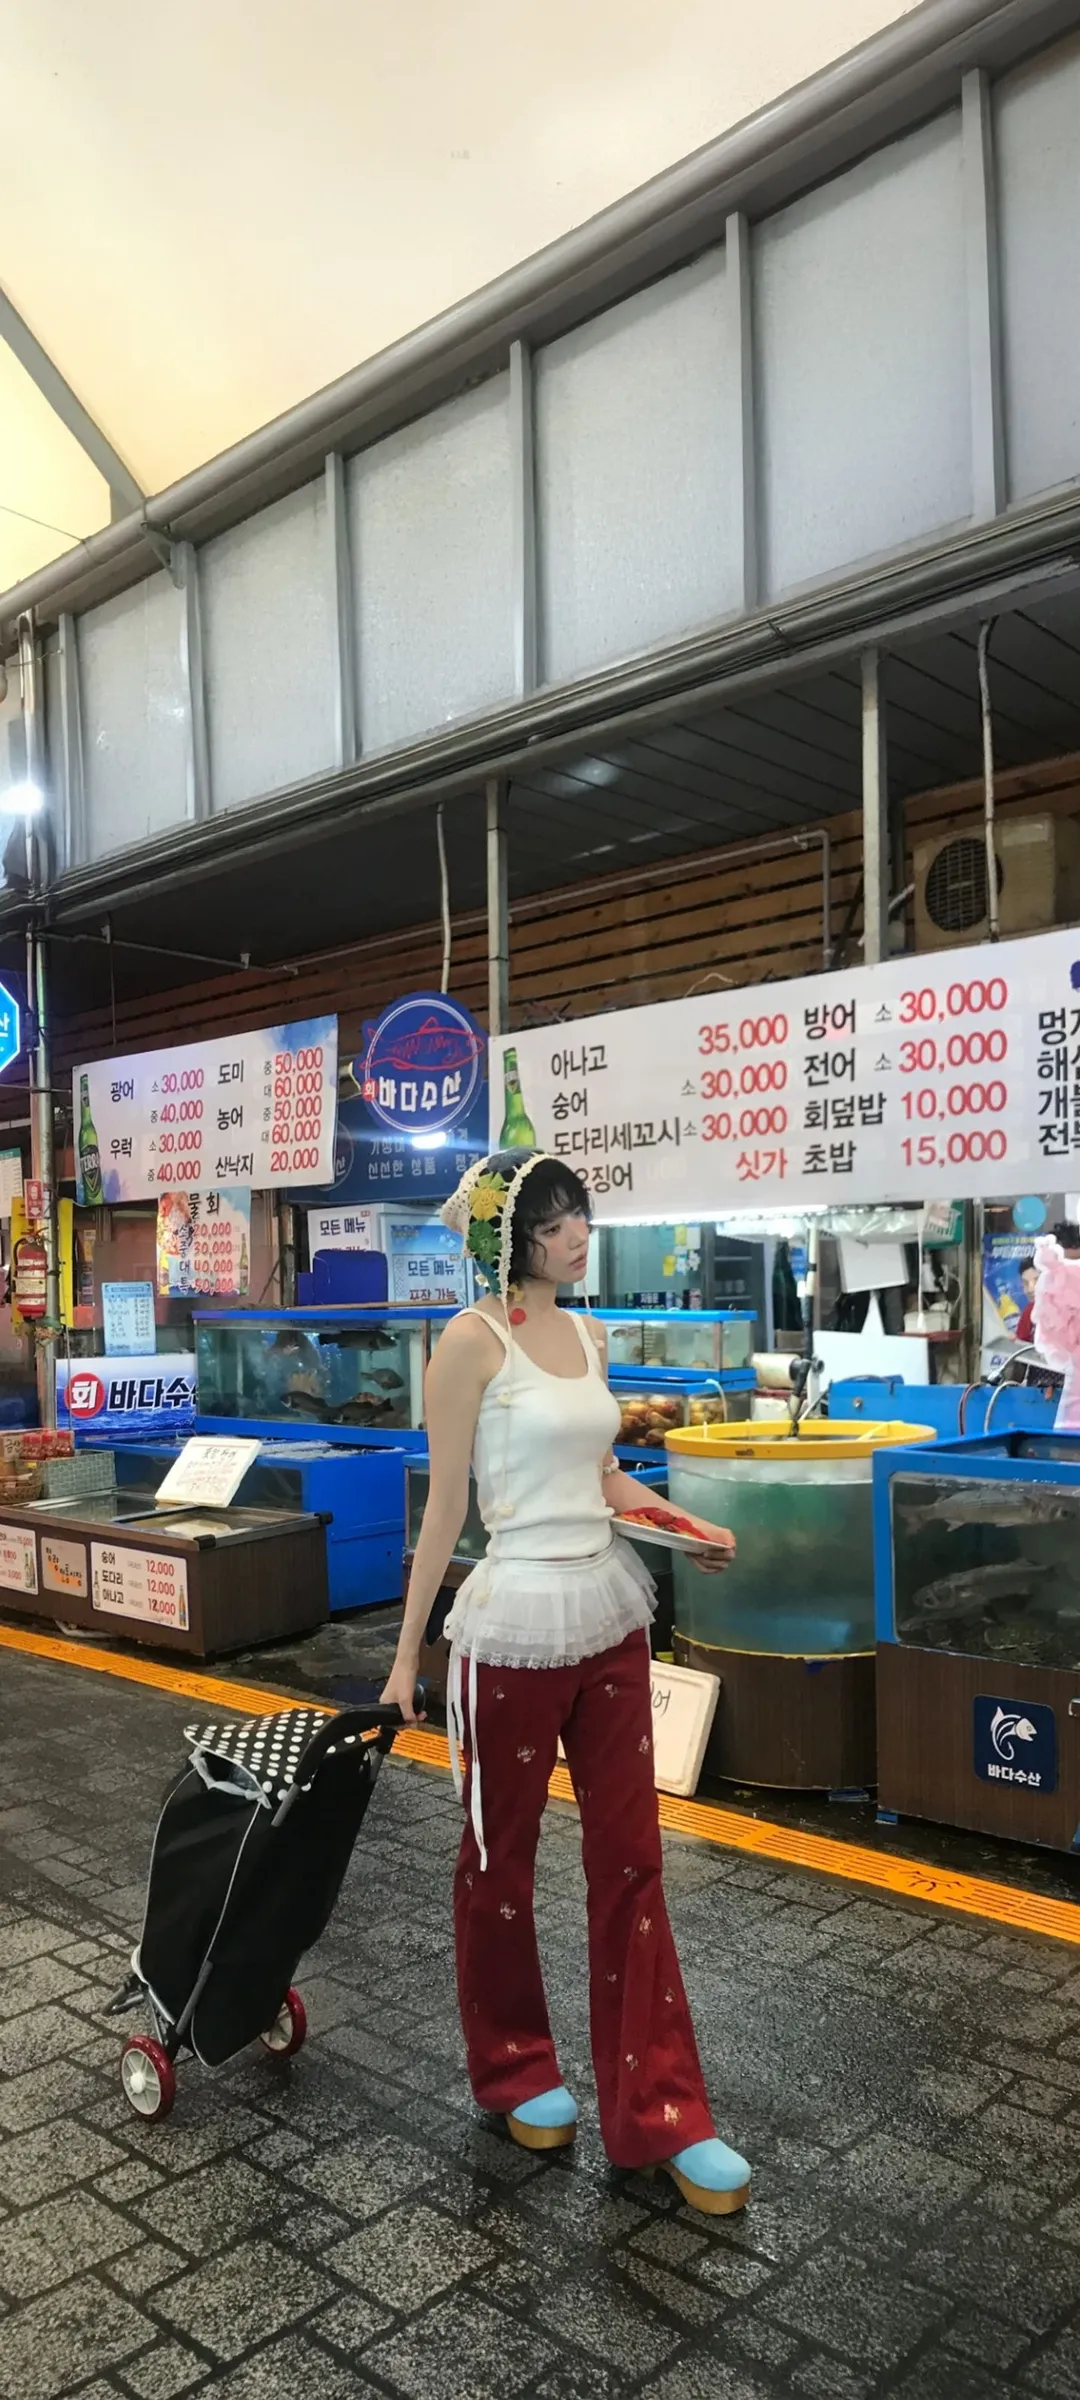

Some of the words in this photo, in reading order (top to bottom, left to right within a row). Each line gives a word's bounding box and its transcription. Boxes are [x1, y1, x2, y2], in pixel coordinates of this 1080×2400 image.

[804, 999, 856, 1040] 방어
[875, 1004, 892, 1022] 소
[899, 978, 1008, 1024] 30,000
[551, 1045, 608, 1079] 아나고
[698, 1014, 788, 1055] 35,000
[804, 1047, 855, 1087] 전어
[874, 1053, 892, 1071] 소
[899, 1030, 1008, 1073] 30,000
[218, 1060, 244, 1084] 도미
[275, 1047, 323, 1075] 50,000
[110, 1078, 134, 1102] 광어
[161, 1068, 204, 1095] 30,000
[274, 1071, 323, 1098] 60,000
[379, 1071, 461, 1112] 바다수산
[552, 1088, 588, 1120] 숭어
[681, 1079, 696, 1096] 소
[701, 1060, 787, 1100] 30,000
[160, 1099, 203, 1124] 40,000
[217, 1105, 243, 1130] 농어
[274, 1095, 322, 1121] 50,000
[803, 1092, 886, 1130] 회덮밥
[901, 1081, 1008, 1121] 10,000
[110, 1137, 132, 1159] 우럭
[159, 1130, 202, 1154] 30,000
[272, 1119, 321, 1145] 60,000
[553, 1116, 680, 1156] 도다리세꼬시
[683, 1120, 697, 1137] 소
[701, 1106, 787, 1142] 30,000
[215, 1153, 253, 1178] 산낙지
[270, 1147, 319, 1173] 20,000
[736, 1149, 787, 1181] 싯가
[802, 1140, 856, 1174] 초밥
[901, 1130, 1008, 1168] 15,000
[157, 1160, 201, 1184] 40,000
[194, 1222, 231, 1239] 20,000
[320, 1219, 341, 1236] 모든
[344, 1217, 366, 1234] 메뉴
[194, 1241, 232, 1258] 30,000
[194, 1260, 233, 1275] 40,000
[408, 1260, 430, 1276] 모든
[434, 1260, 455, 1276] 메뉴
[70, 1380, 99, 1409] 회
[108, 1377, 196, 1410] 바다수
[102, 1569, 124, 1586] 도다리
[147, 1578, 175, 1597] 12,000
[146, 1559, 175, 1577] 12,000
[102, 1588, 124, 1604] 아나고
[987, 1763, 1042, 1787] 바다수산
